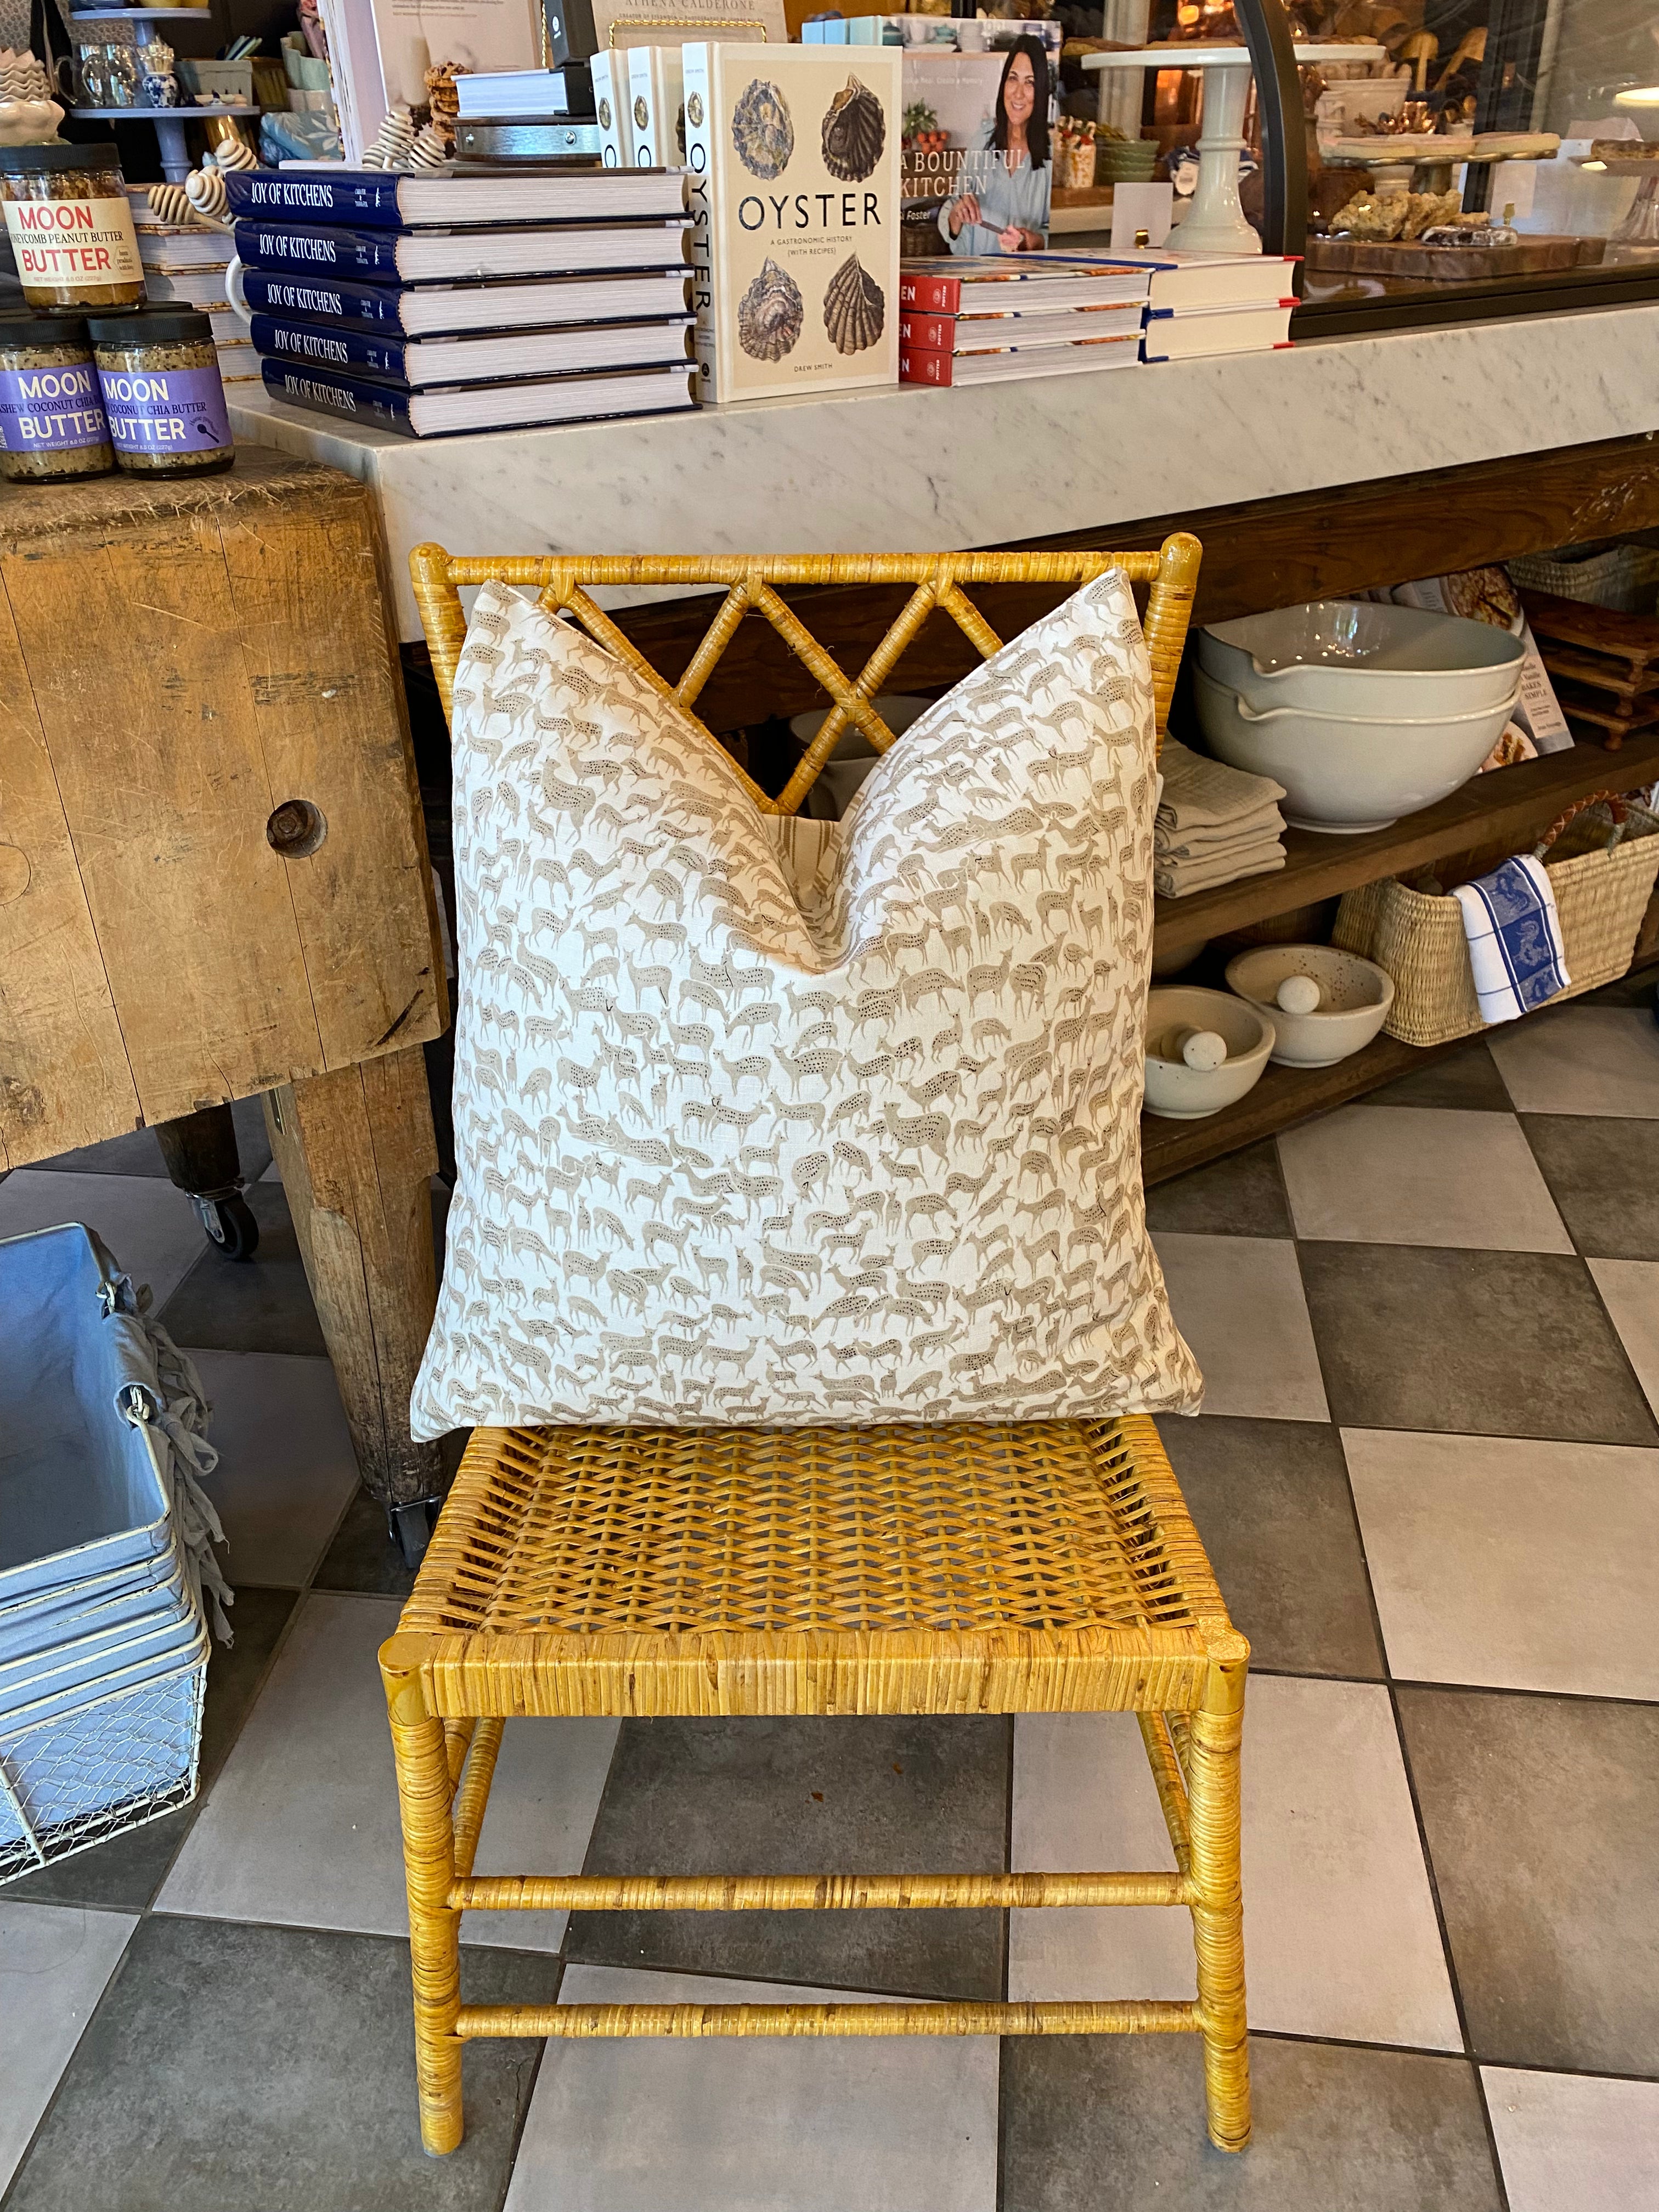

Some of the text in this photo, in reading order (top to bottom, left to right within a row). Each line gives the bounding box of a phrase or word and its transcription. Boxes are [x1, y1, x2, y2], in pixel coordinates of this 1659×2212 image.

[914, 149, 1025, 172] BOUNTIFUL
[251, 182, 267, 204] JOY
[269, 183, 282, 204] OF
[284, 183, 333, 208] KITCHENS
[901, 175, 987, 198] KITCHEN
[18, 206, 94, 230] MOON
[738, 193, 882, 230] OYSTER
[906, 210, 931, 221] Foster
[49, 232, 88, 244] PEANUT
[91, 231, 123, 242] BUTTER
[690, 142, 711, 311] OYSTER
[259, 234, 274, 255] JOY
[276, 236, 288, 256] OF
[290, 237, 336, 263] KITCHENS
[777, 236, 825, 245] GASTRONOMIC
[826, 235, 853, 244] HISTORY
[21, 247, 112, 273] BUTTER
[267, 284, 281, 304] JOY
[283, 286, 295, 307] OF
[296, 288, 342, 315] KITCHENS
[274, 329, 289, 350] JOY
[290, 332, 302, 353] OF
[303, 335, 348, 364] KITCHENS
[18, 370, 92, 399] MOON
[103, 377, 170, 402] MOON
[285, 374, 298, 396] JOY
[300, 379, 311, 399] OF
[312, 382, 357, 412] KITCHENS
[27, 399, 74, 413] COCONUT
[75, 397, 93, 408] CHIA
[111, 403, 146, 415] COCONUT
[146, 404, 171, 415] CHIA
[172, 402, 207, 414] BUTTER
[18, 409, 106, 439] BUTTER
[108, 416, 187, 441] BUTTER
